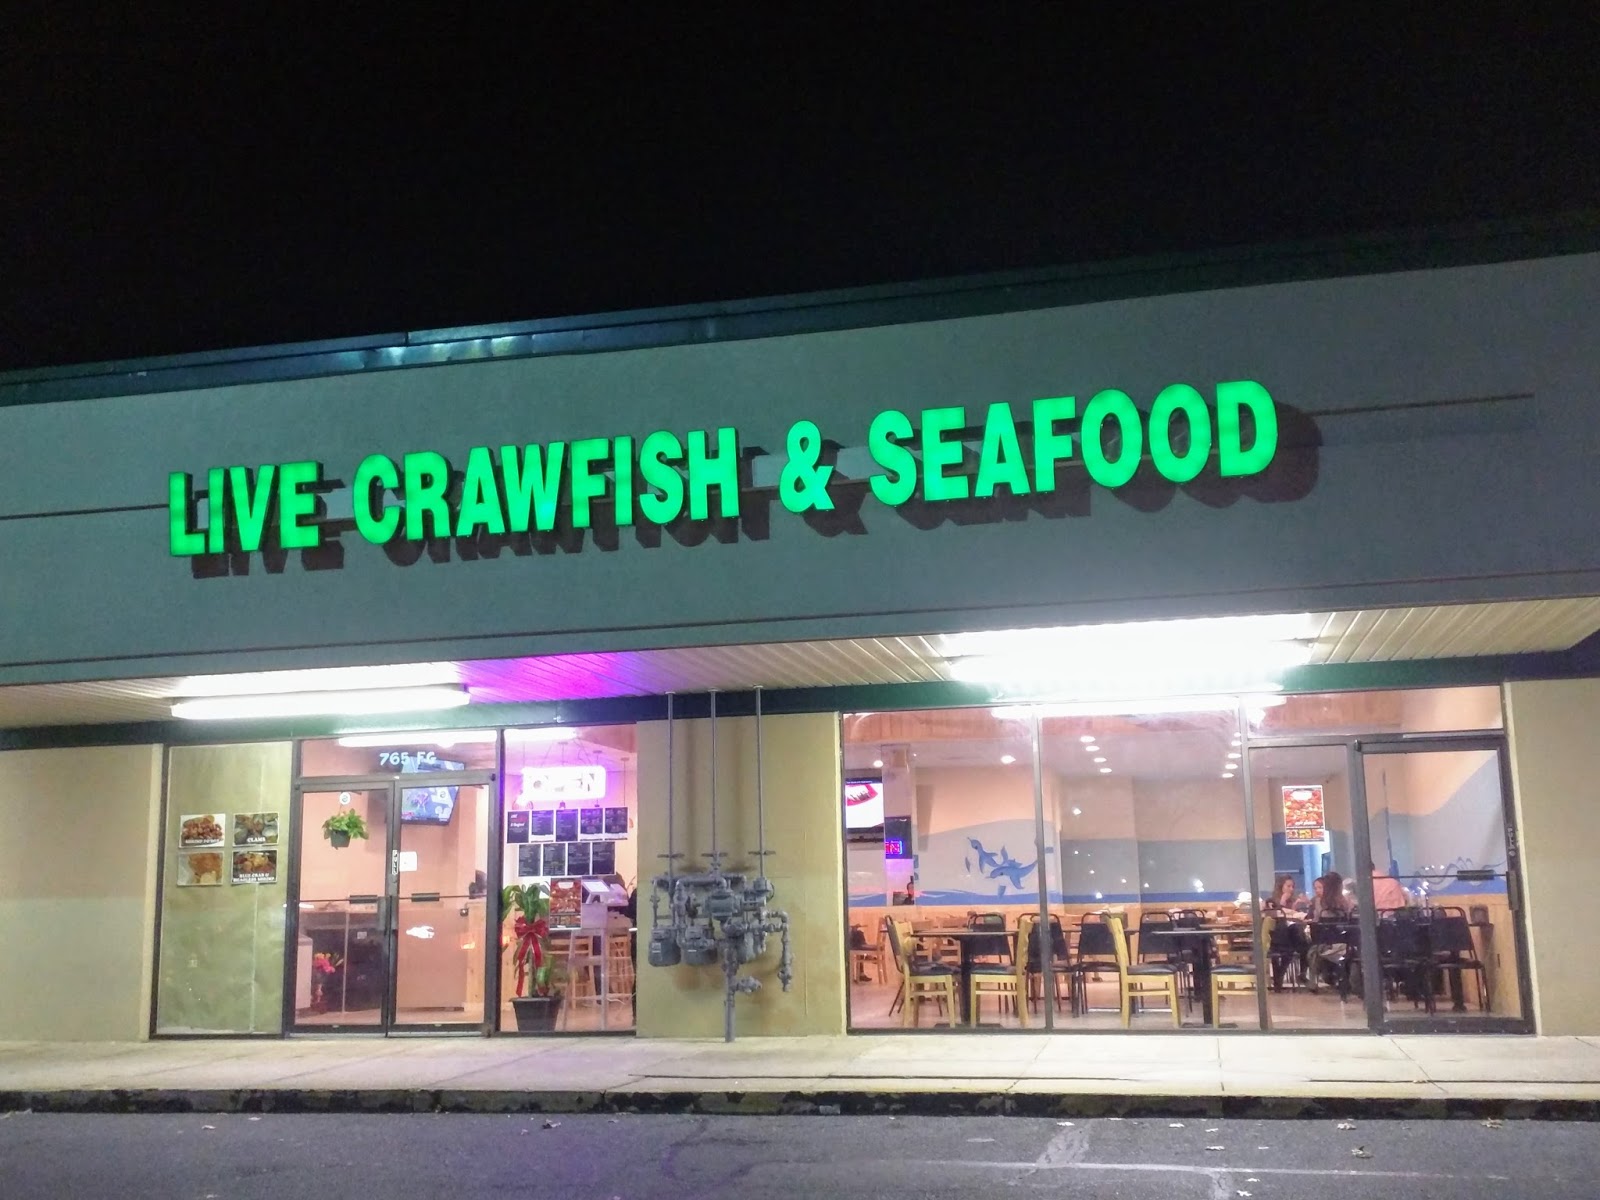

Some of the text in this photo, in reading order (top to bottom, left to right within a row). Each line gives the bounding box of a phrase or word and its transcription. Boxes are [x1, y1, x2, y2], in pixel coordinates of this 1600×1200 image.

[168, 379, 1279, 557] LIVE CRAWFISH & SEAFOOD
[379, 751, 436, 766] 765 FG
